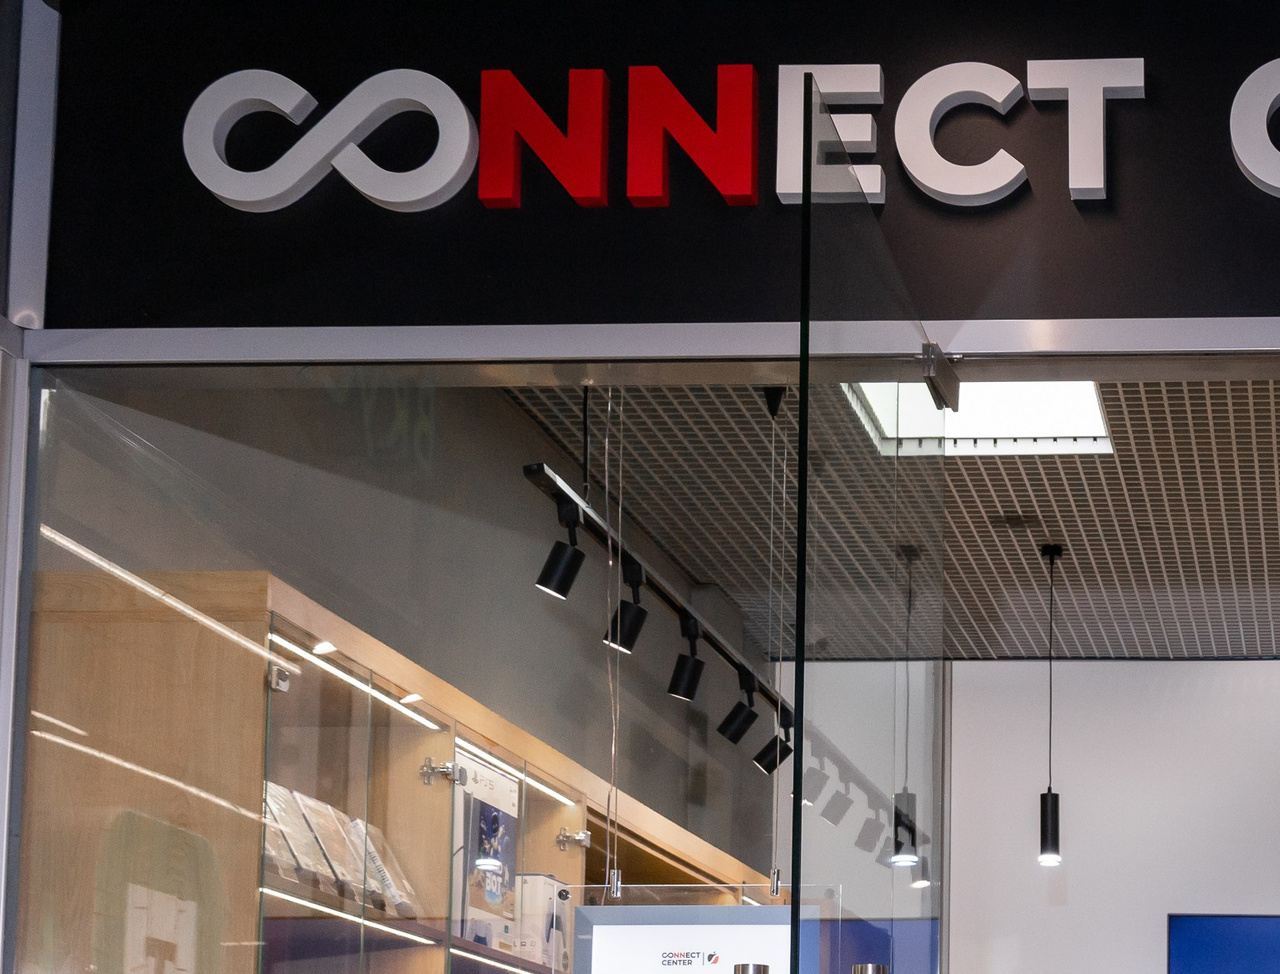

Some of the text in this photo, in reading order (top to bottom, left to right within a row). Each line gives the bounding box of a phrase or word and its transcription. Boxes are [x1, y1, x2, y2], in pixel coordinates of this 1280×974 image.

[183, 57, 1145, 213] CONNECT
[485, 874, 503, 894] BOT
[661, 951, 701, 959] CONNECT
